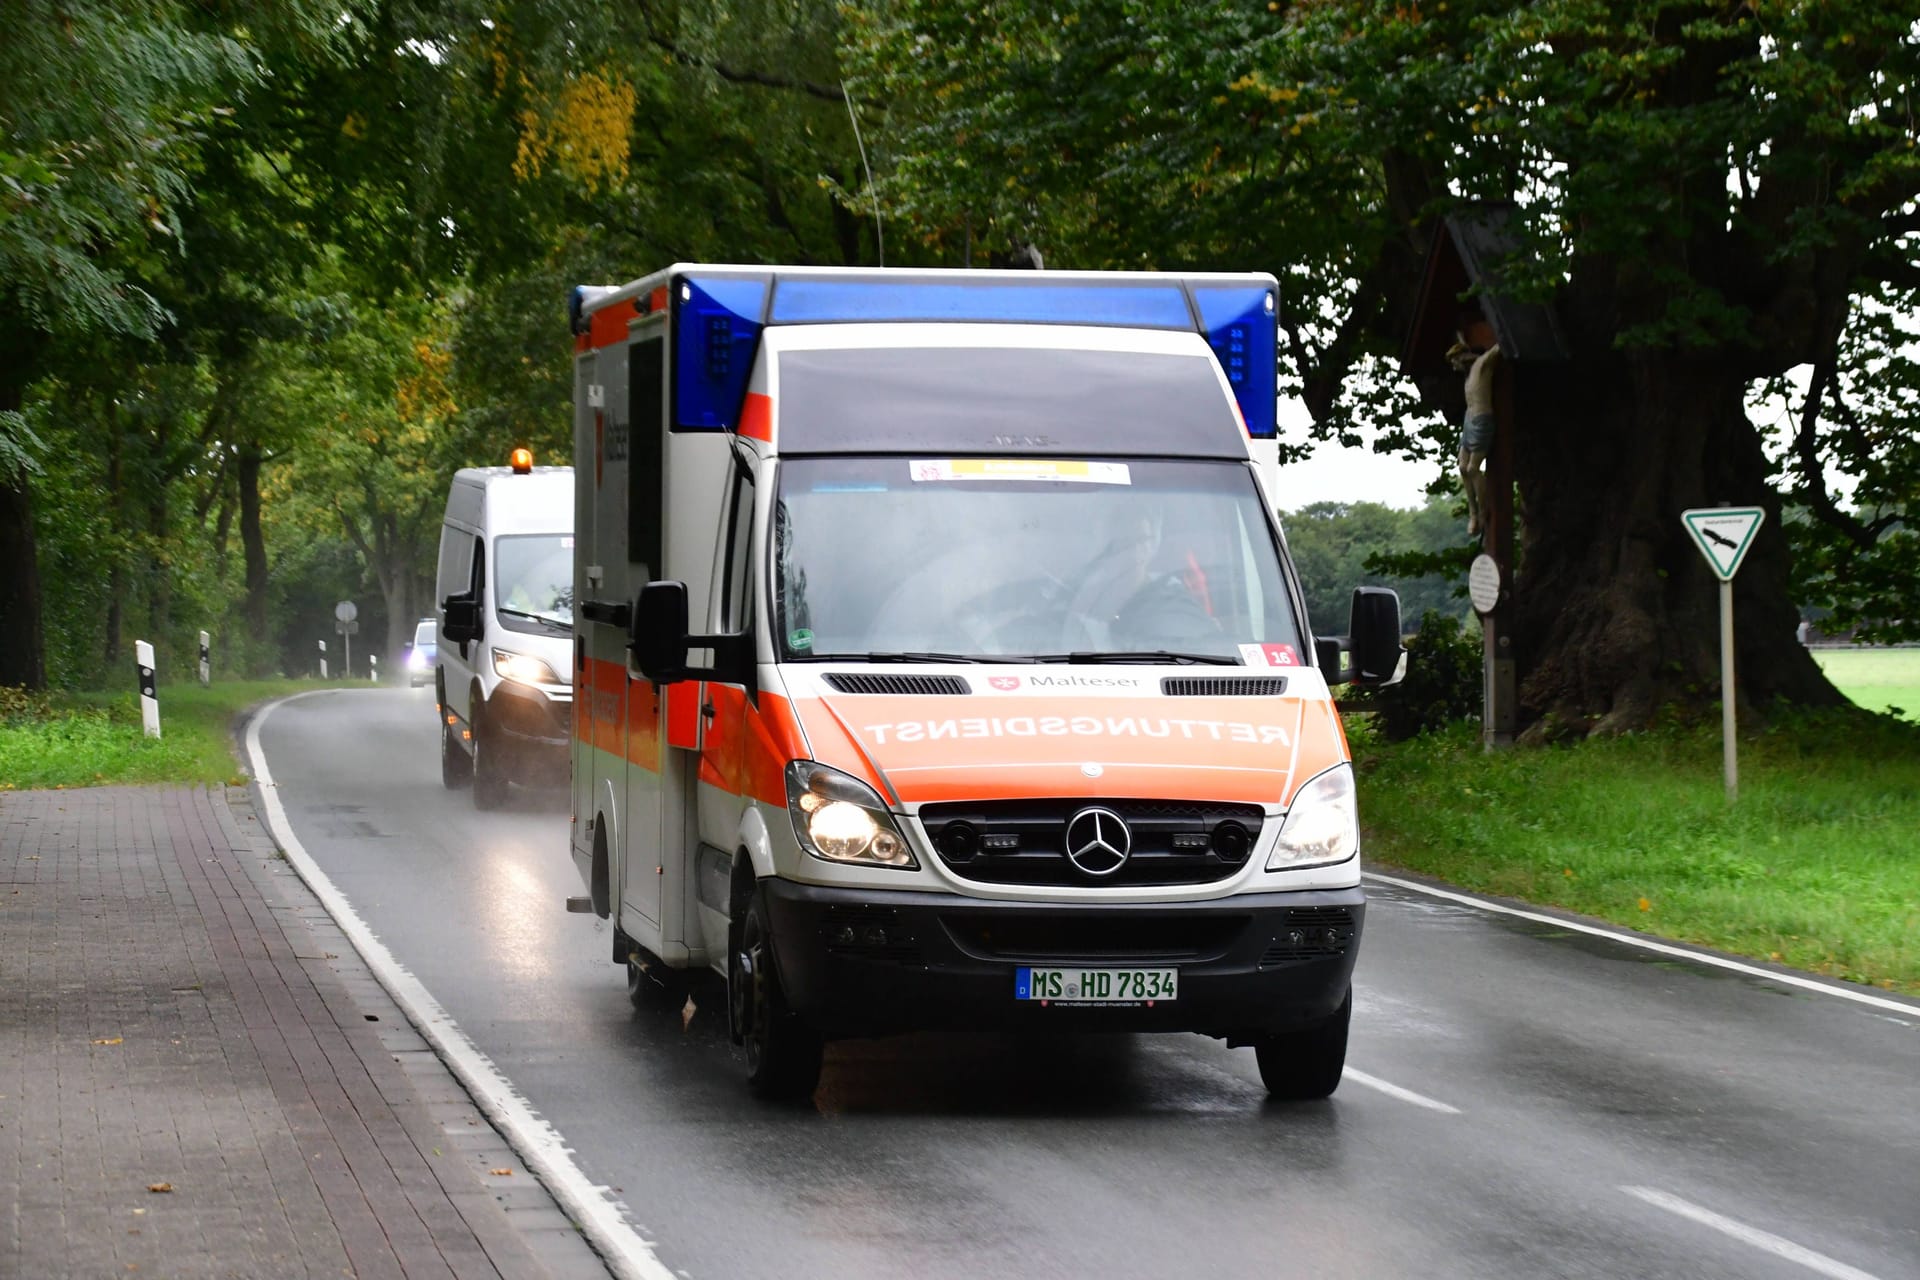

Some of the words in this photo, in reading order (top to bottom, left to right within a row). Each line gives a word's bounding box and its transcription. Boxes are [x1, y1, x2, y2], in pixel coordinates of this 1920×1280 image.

[1271, 651, 1292, 665] 16
[1030, 675, 1141, 688] Malteser
[1019, 986, 1026, 995] D
[1032, 972, 1063, 998] MS
[1081, 972, 1111, 998] HD
[1118, 972, 1175, 998] 7834
